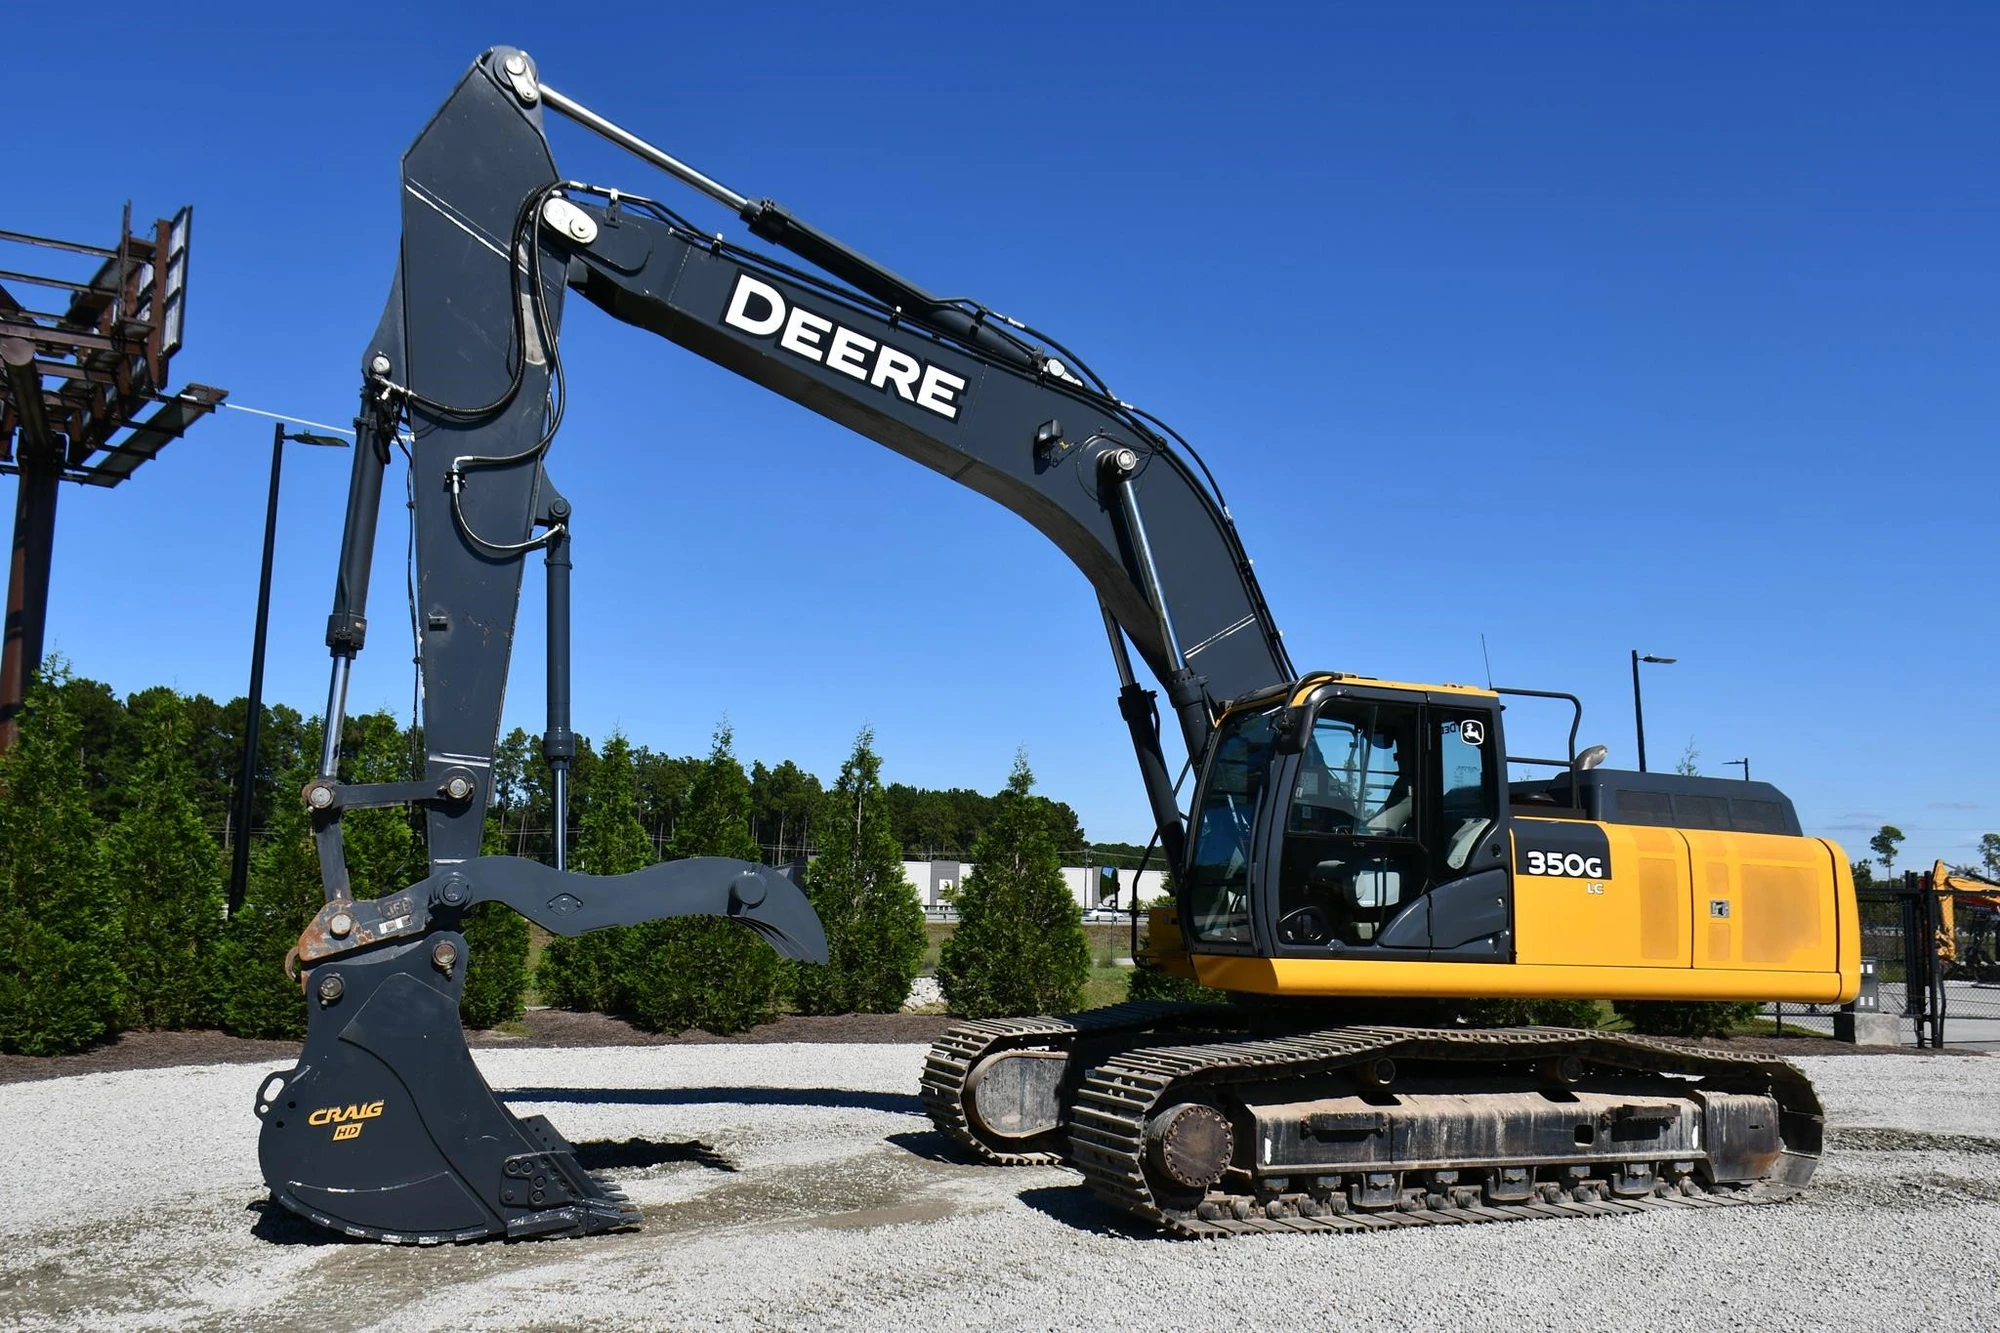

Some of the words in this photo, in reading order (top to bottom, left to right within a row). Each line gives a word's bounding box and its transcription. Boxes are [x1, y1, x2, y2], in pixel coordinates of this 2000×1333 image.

[725, 273, 965, 418] DEERE
[1528, 850, 1602, 878] 350G
[1587, 883, 1604, 894] LC
[308, 1100, 385, 1125] CRAIG
[335, 1125, 360, 1138] HD
